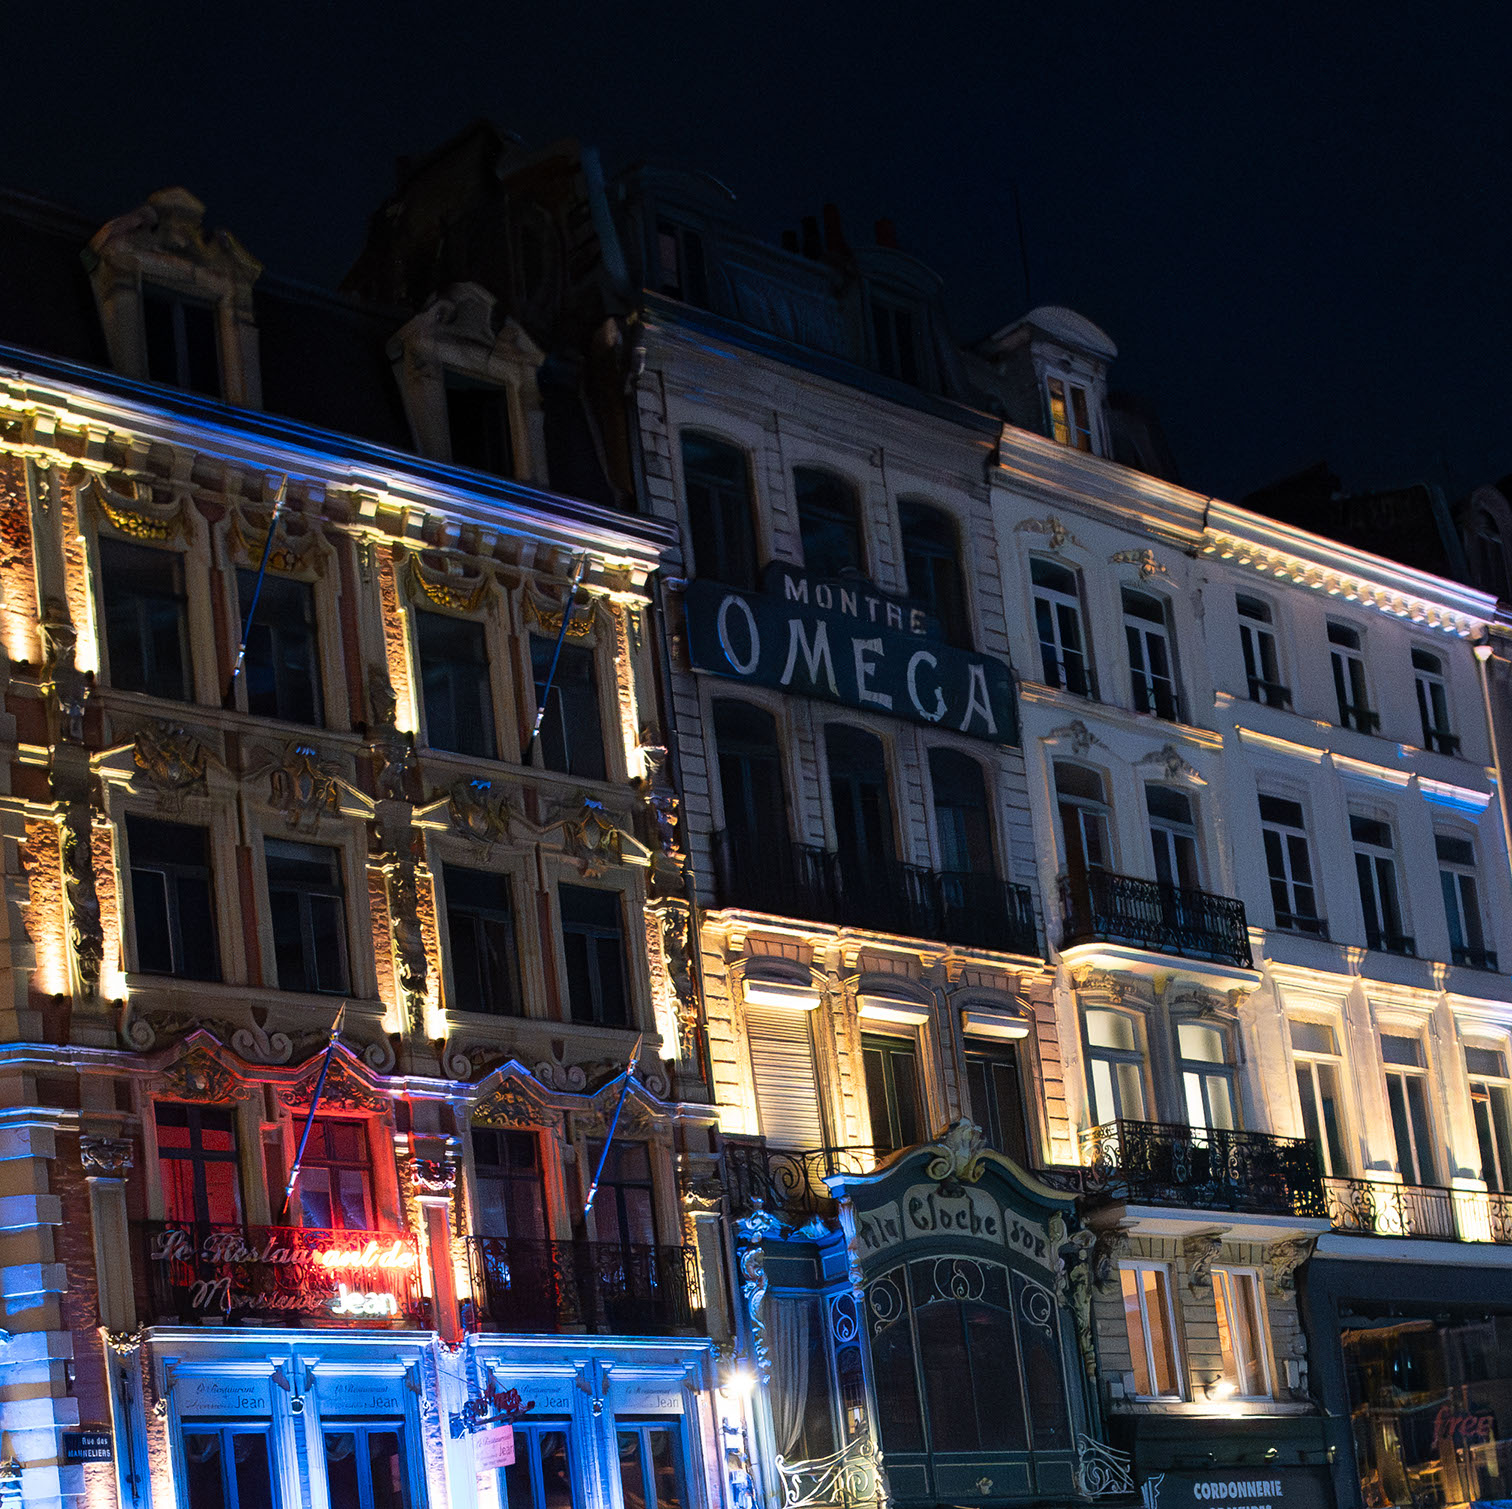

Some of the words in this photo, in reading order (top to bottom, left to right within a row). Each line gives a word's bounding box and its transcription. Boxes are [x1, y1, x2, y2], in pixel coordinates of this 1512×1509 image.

[784, 574, 928, 635] MONTRE
[717, 594, 999, 695] OMEGA
[332, 1282, 398, 1315] Jean
[235, 1396, 266, 1409] Jean
[370, 1396, 399, 1409] Jean
[544, 1396, 570, 1408] Jean
[656, 1395, 680, 1408] Jean
[81, 1437, 94, 1445] Rue
[96, 1437, 108, 1445] des
[68, 1449, 111, 1458] MANNELIERS
[1194, 1480, 1284, 1500] CORDONNERIE
